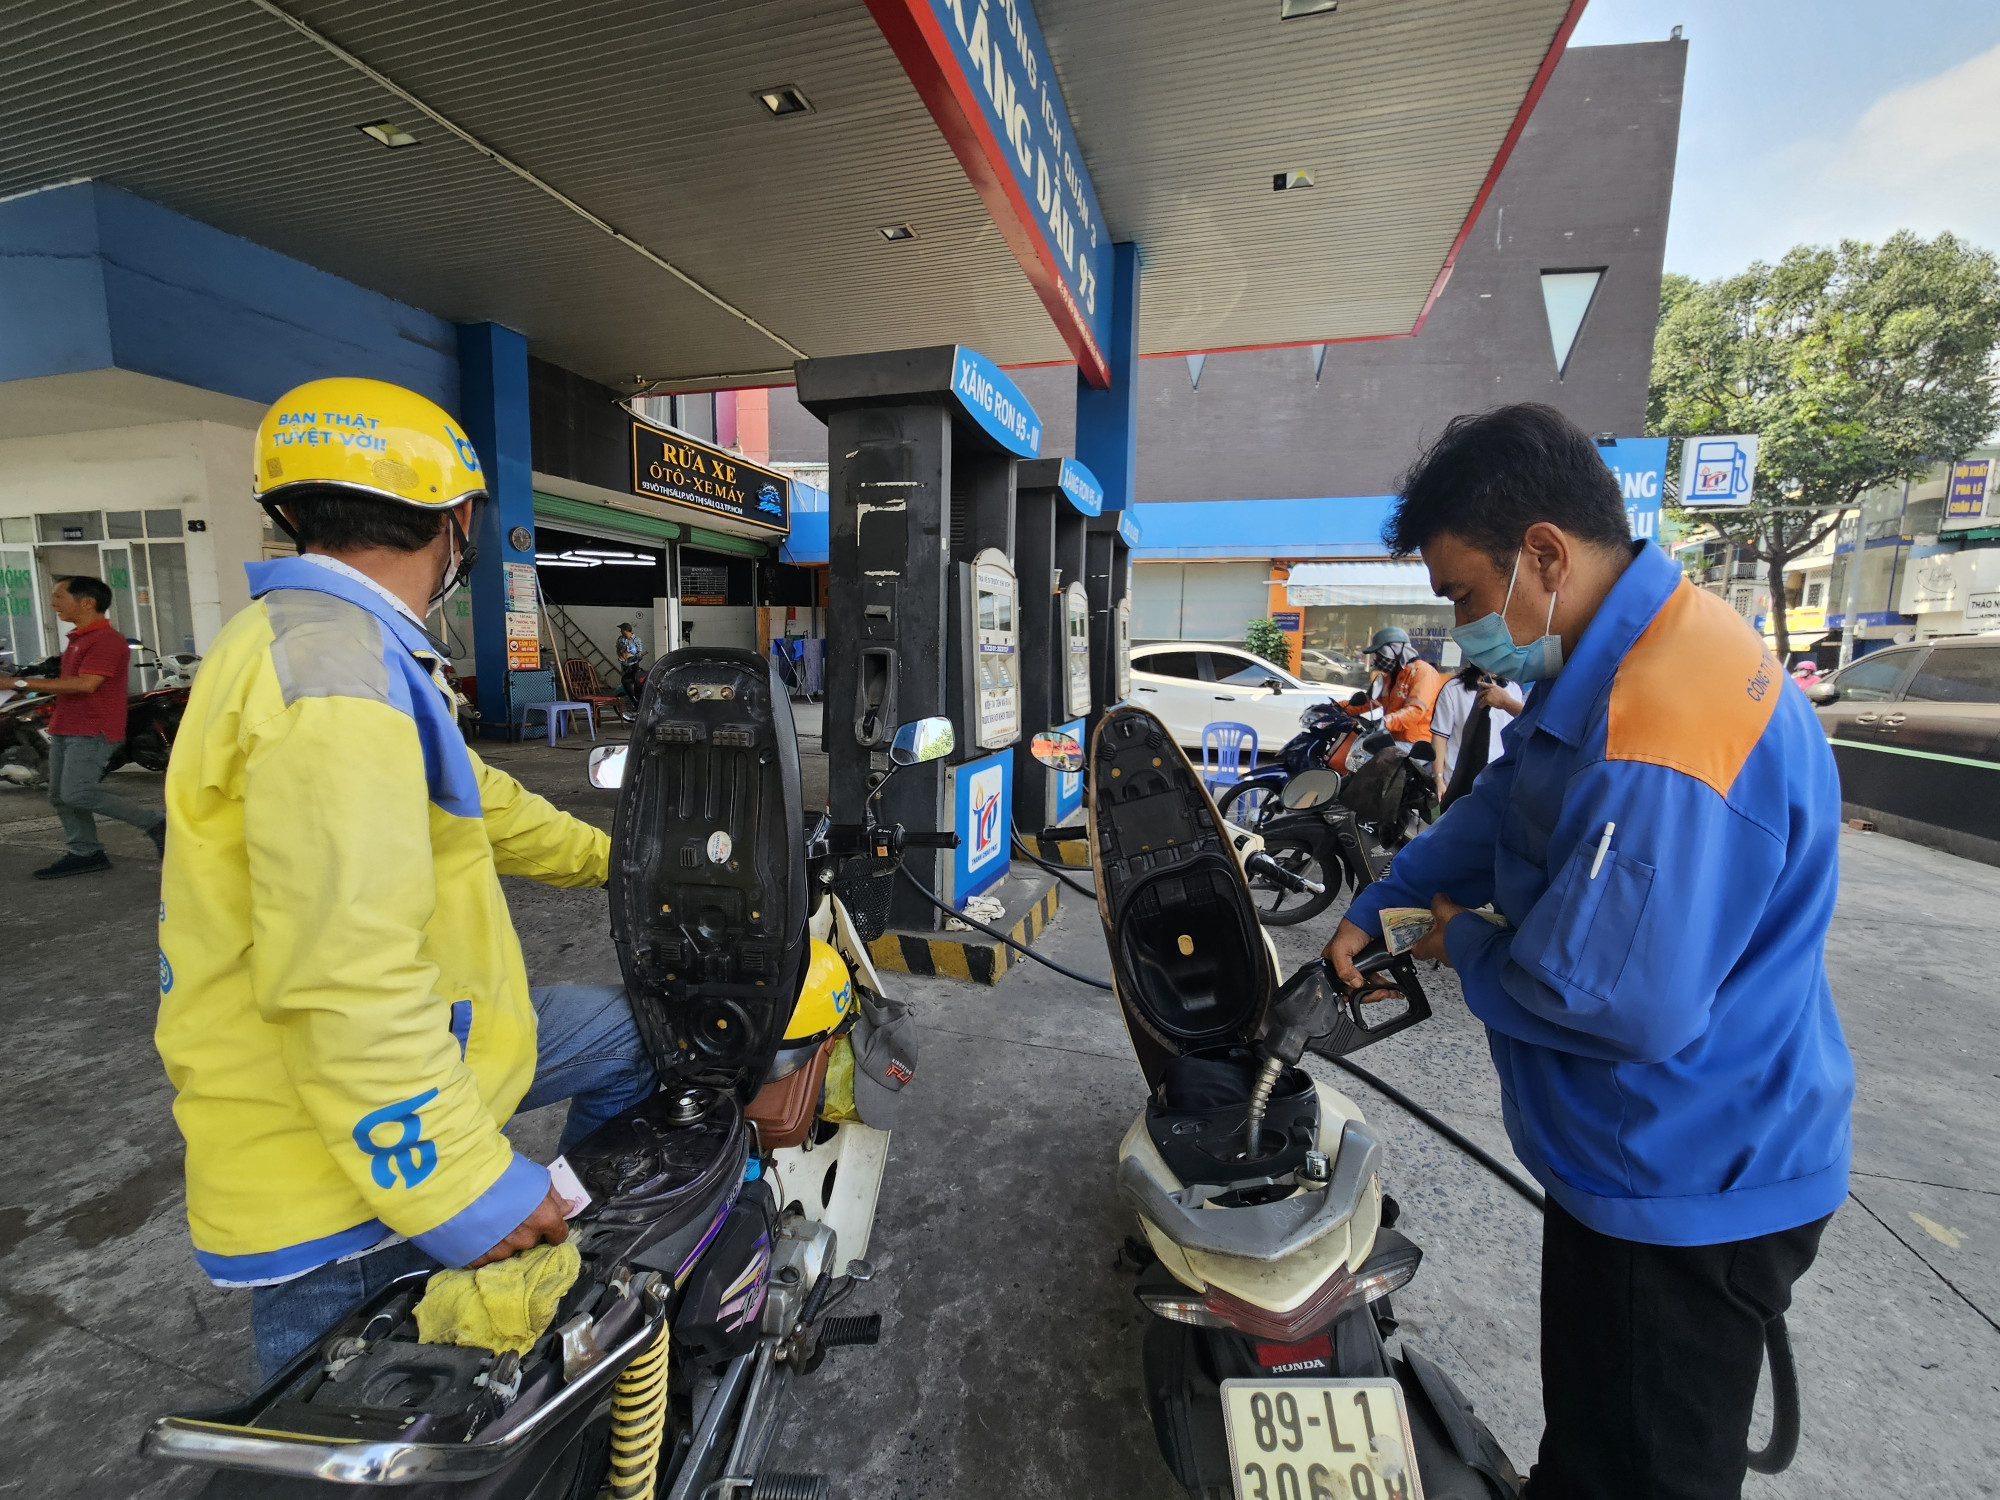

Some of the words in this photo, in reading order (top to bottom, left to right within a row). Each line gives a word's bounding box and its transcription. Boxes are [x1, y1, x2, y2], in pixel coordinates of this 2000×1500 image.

[998, 0, 1037, 90] ÔNG
[1041, 80, 1061, 157] ÍCH
[1090, 223, 1097, 248] 3
[1036, 146, 1075, 272] DẦU
[1078, 253, 1096, 315] 93
[278, 412, 316, 428] BẠN
[323, 412, 380, 431] THẬT
[958, 359, 993, 412] XĂNG
[994, 390, 1016, 432] RON
[1015, 411, 1027, 442] 95
[662, 441, 706, 474] RỬA
[712, 460, 737, 485] XE
[715, 483, 745, 504] MÁY
[1272, 1358, 1326, 1374] HONDA
[1250, 1390, 1379, 1453] 89-L1
